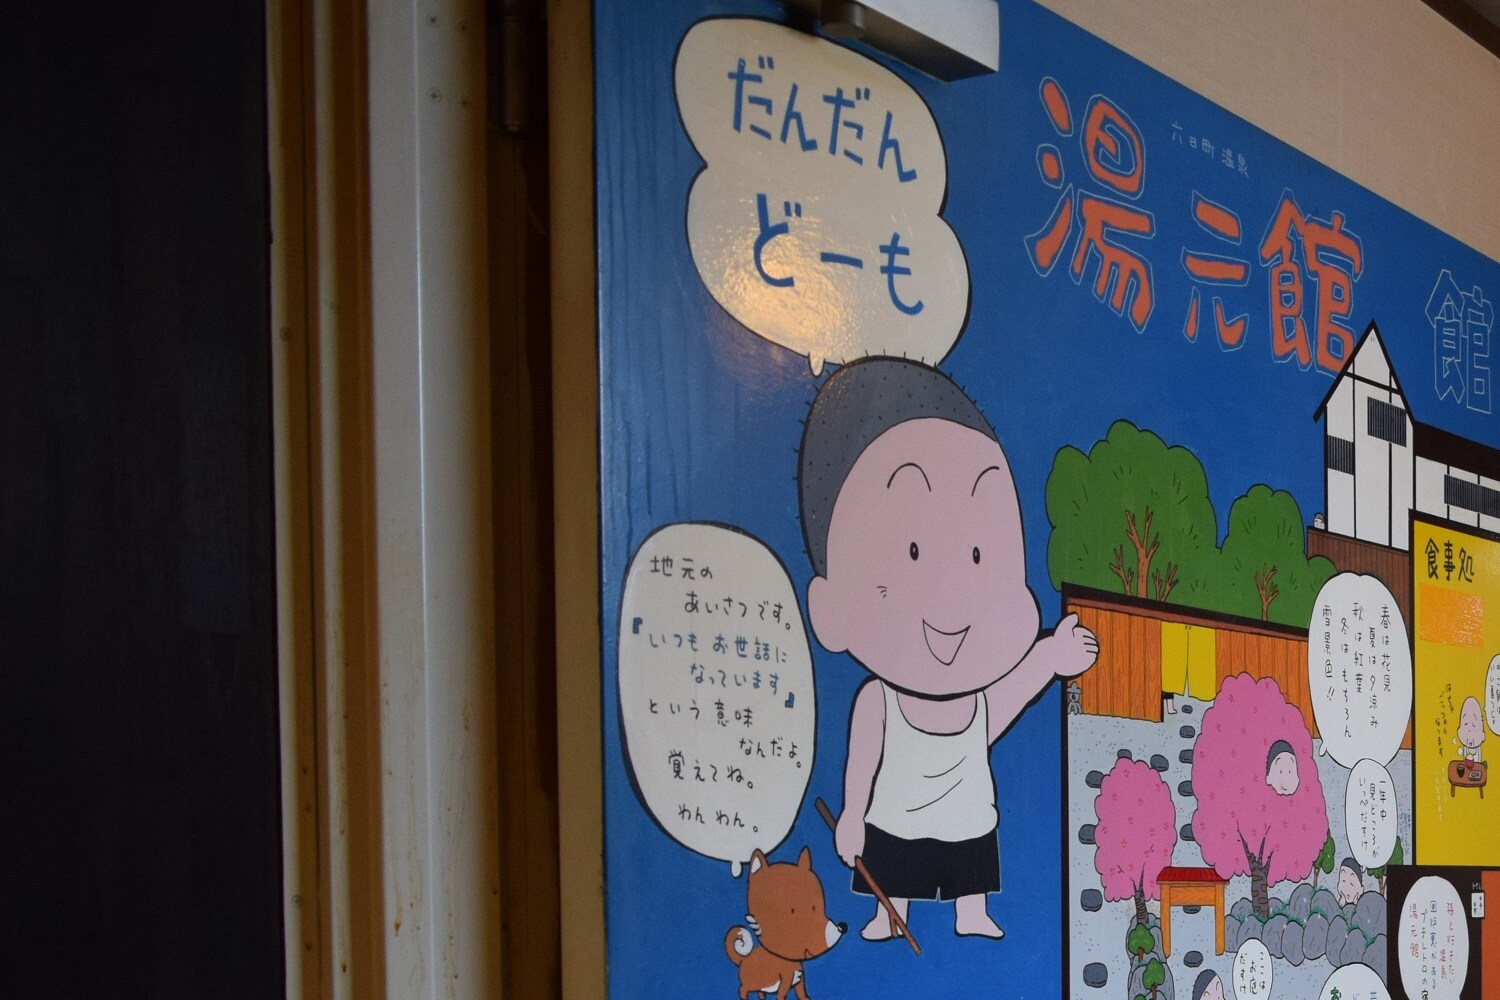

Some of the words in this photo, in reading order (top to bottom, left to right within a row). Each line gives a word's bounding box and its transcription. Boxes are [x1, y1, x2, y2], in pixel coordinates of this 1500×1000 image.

[727, 56, 918, 183] だんだん
[753, 193, 924, 315] どーも
[1024, 77, 1364, 379] 湯元館
[650, 556, 713, 580] 地元の
[1425, 538, 1474, 583] 食事処
[684, 591, 792, 630] あいさつです。
[1341, 617, 1352, 738] 冬はもちろん
[1352, 602, 1364, 694] 秋は紅葉
[1369, 626, 1379, 730] 夏は夕涼み
[1380, 604, 1391, 693] 春は花見
[649, 698, 754, 728] という意味
[667, 749, 754, 790] 覚えてね。
[738, 736, 802, 769] なんだよ。
[678, 803, 760, 833] わんわん。
[1370, 782, 1380, 858] 見どころが
[1379, 780, 1387, 821] 一年中
